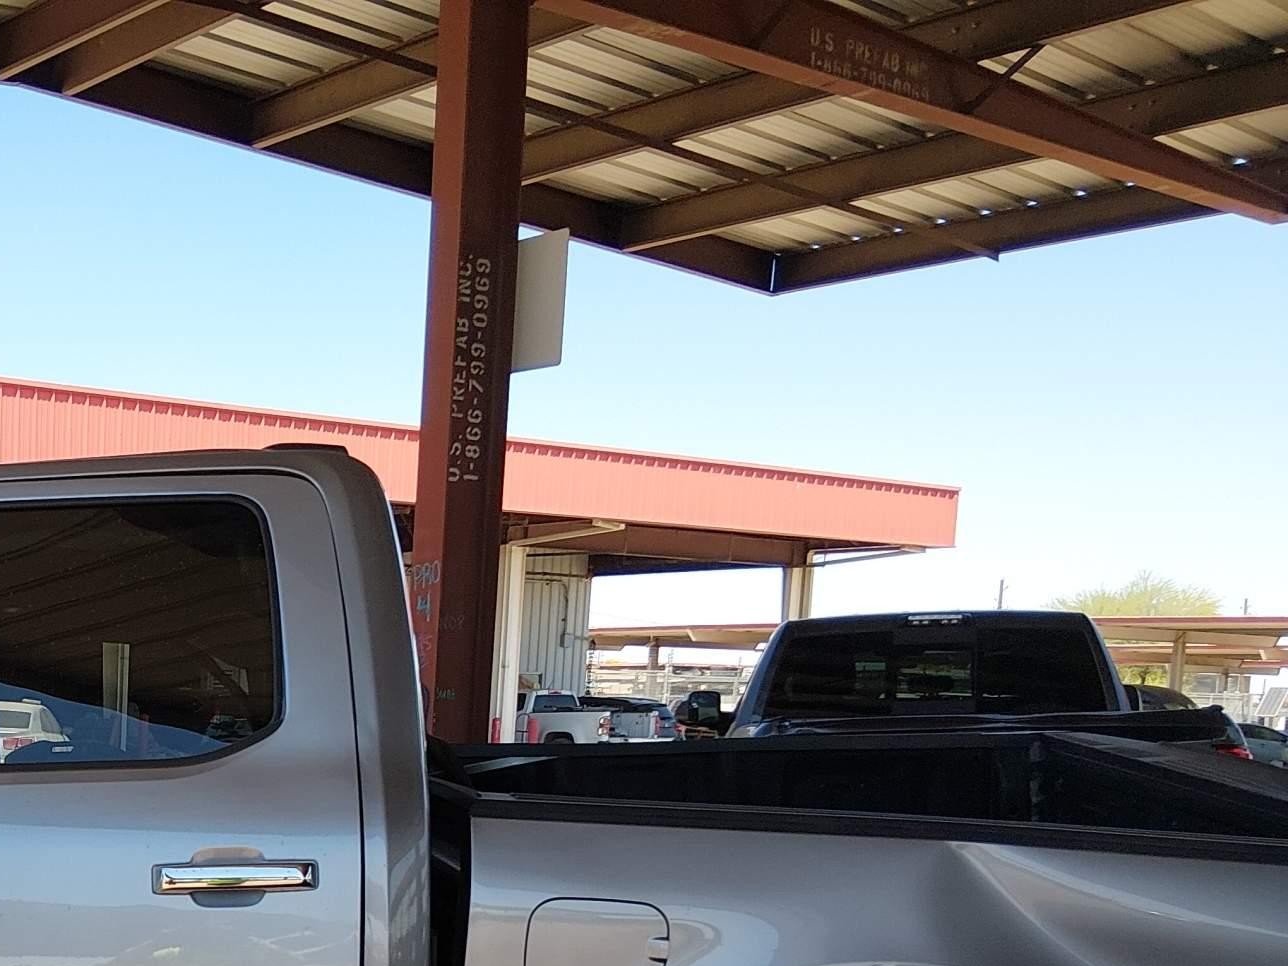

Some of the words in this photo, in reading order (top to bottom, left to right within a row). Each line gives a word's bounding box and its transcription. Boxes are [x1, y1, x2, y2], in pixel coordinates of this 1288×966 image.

[457, 254, 474, 303] INC.
[450, 317, 470, 419] PREFAB
[462, 258, 492, 482] 1-866-799-0969
[447, 434, 463, 483] U.S.
